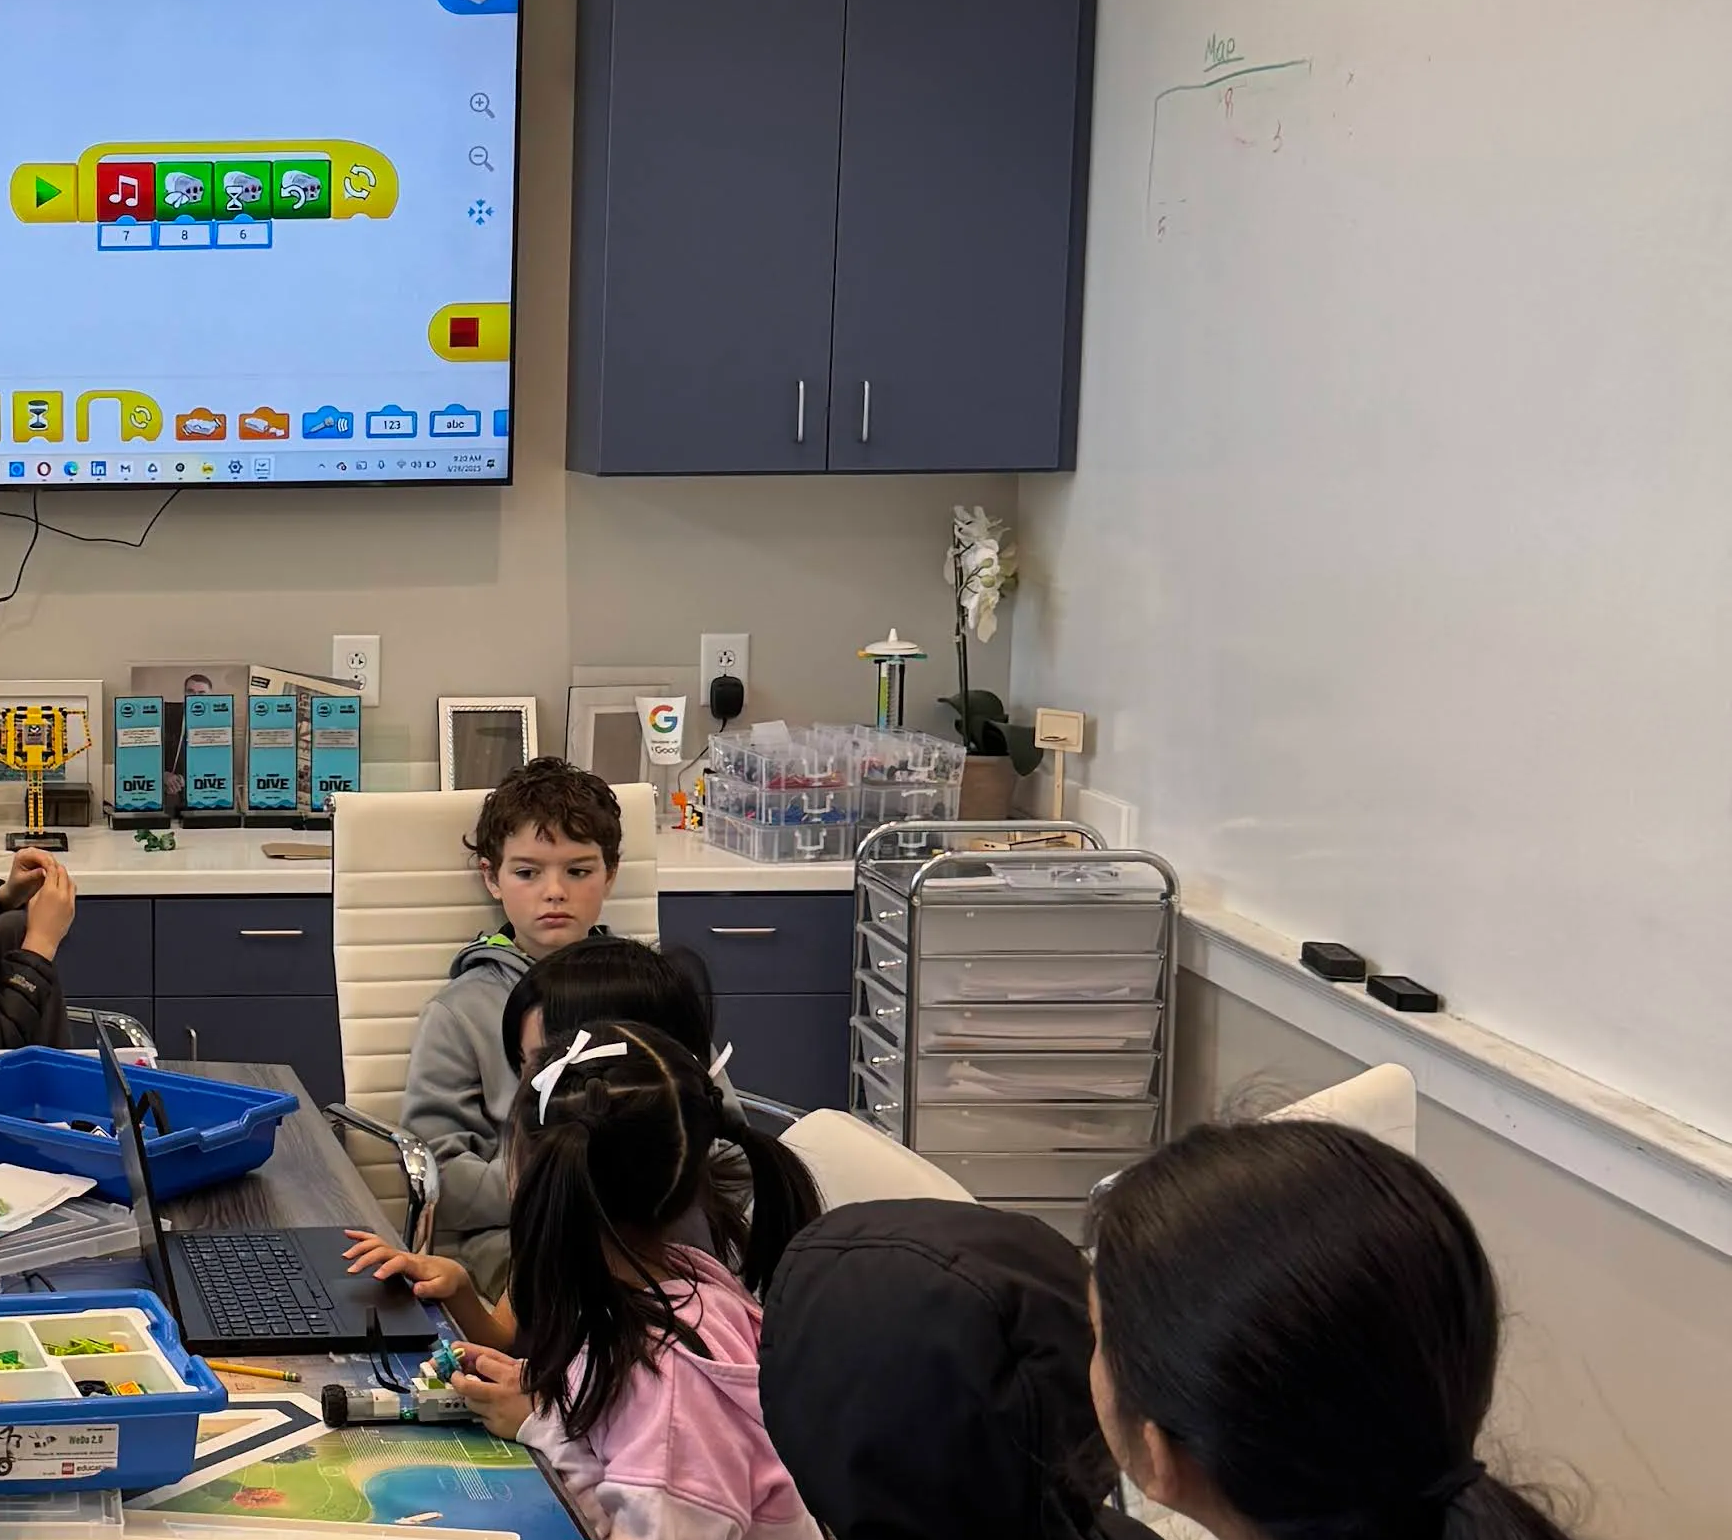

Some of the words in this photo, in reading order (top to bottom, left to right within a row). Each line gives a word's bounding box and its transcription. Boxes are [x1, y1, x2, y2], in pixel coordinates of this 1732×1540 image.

[1204, 34, 1236, 63] Map
[123, 230, 130, 241] 7
[181, 230, 188, 241] 8
[240, 229, 247, 240] 6
[383, 420, 402, 430] 123
[446, 418, 465, 429] abc
[123, 780, 156, 792] DIVE
[194, 778, 226, 789] DIVE
[257, 778, 290, 790] DIVE
[319, 780, 352, 792] DIVE
[69, 1436, 90, 1445] WeDo
[91, 1435, 104, 1444] 2.0
